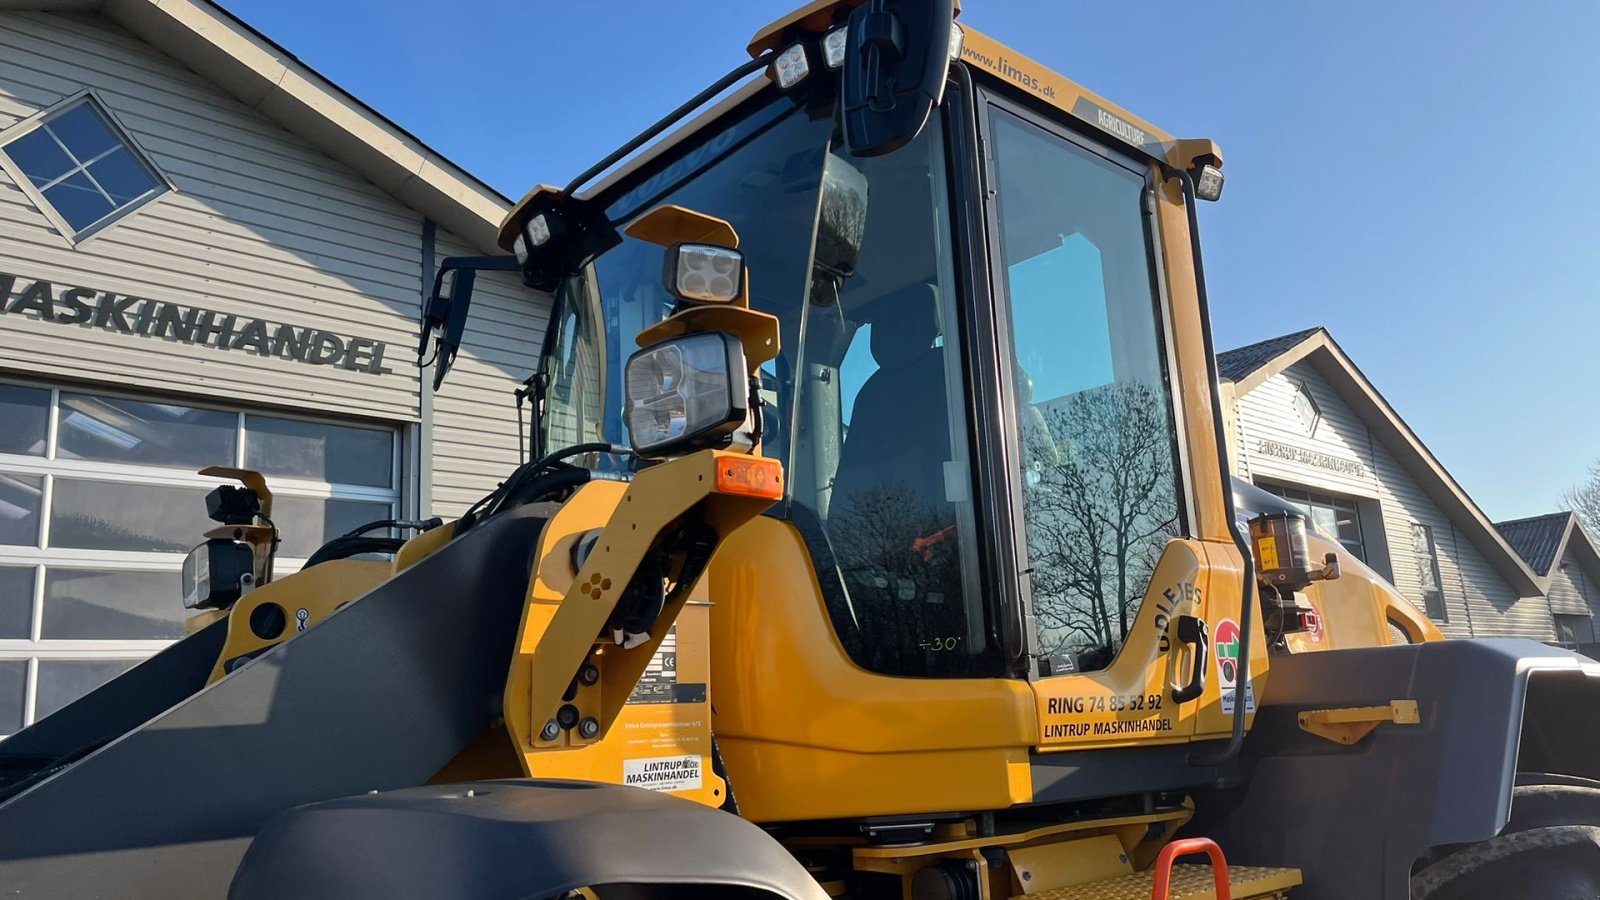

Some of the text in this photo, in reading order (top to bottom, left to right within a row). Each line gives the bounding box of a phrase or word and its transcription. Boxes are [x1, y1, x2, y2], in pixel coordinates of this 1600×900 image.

[963, 46, 1055, 99] www.limas.dk
[1098, 109, 1145, 147] AGRICULTURE
[1155, 582, 1202, 652] UDLEJES
[1048, 694, 1162, 714] RING 74 85 52 92
[1044, 718, 1172, 738] LINTRUP MASKINHANDEL
[644, 760, 682, 772] LINTRUP
[626, 769, 700, 784] MASKINHANDEL
